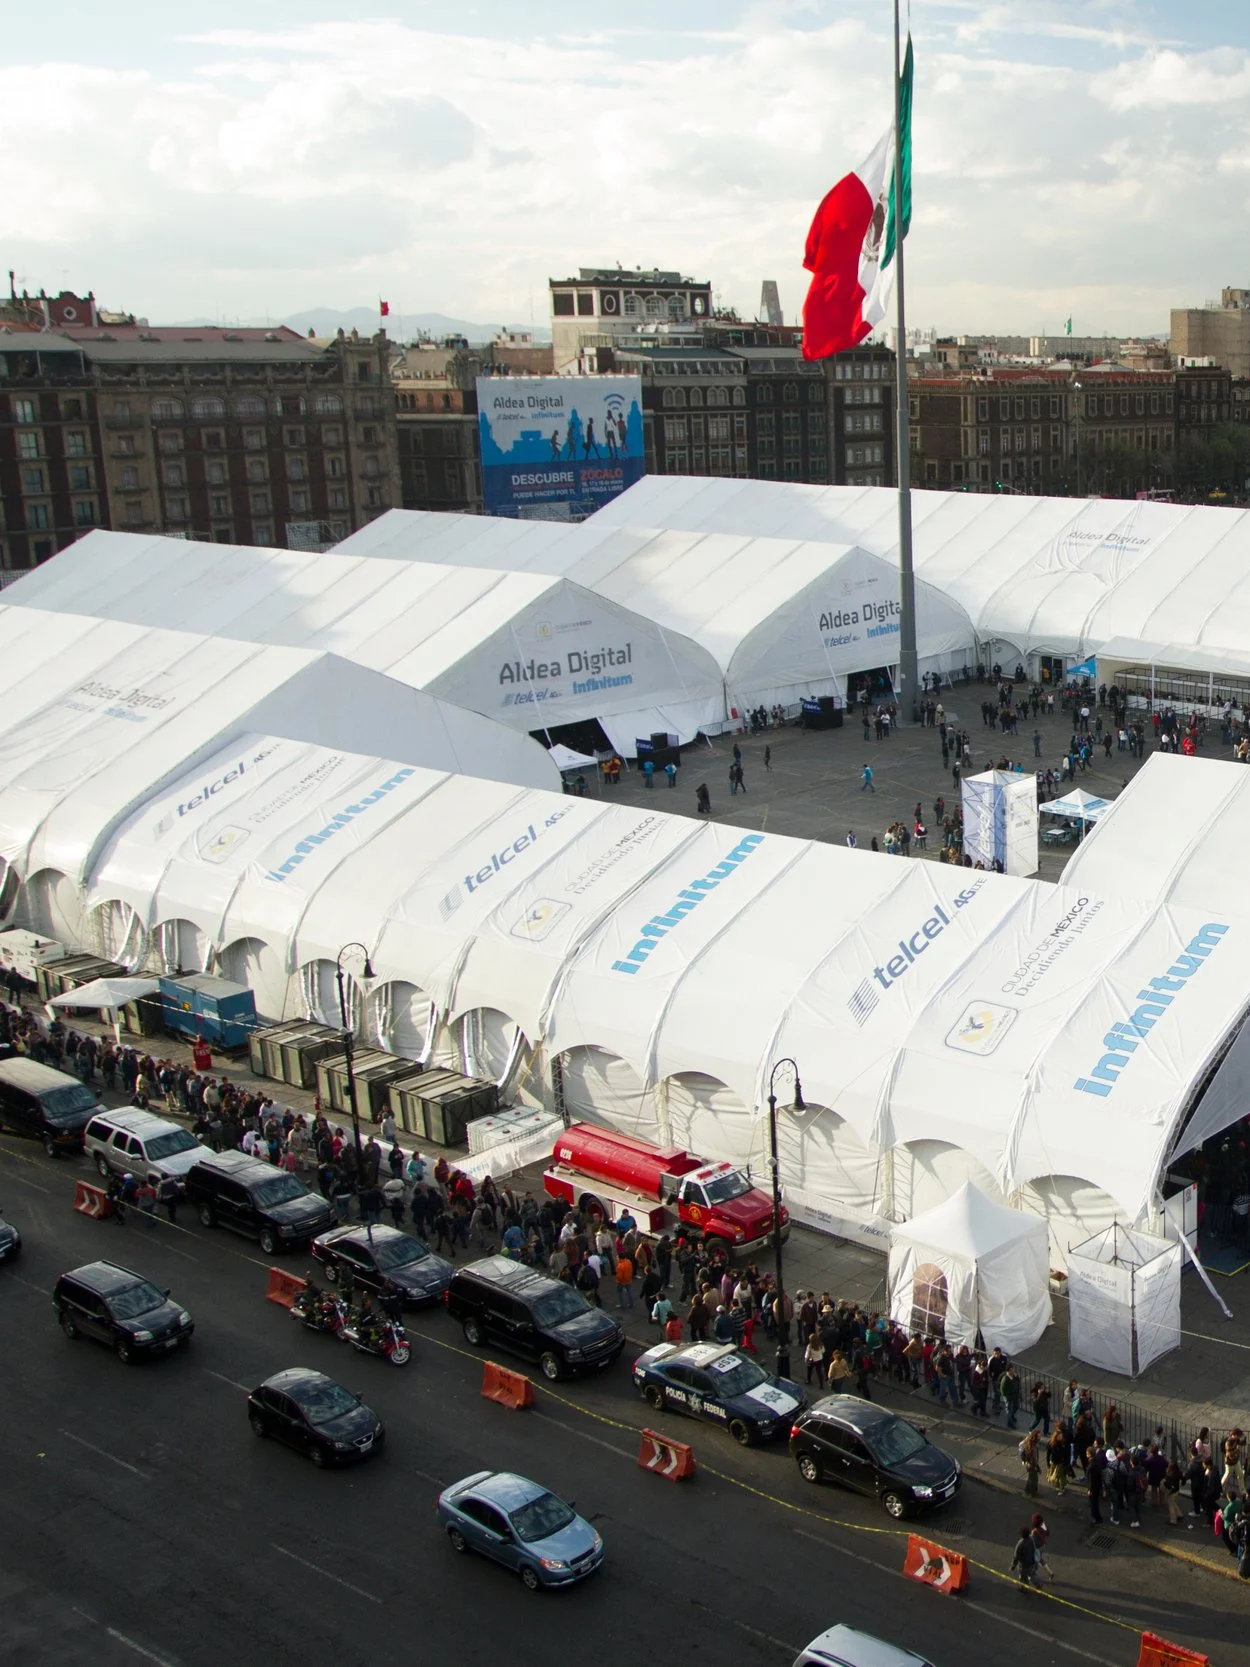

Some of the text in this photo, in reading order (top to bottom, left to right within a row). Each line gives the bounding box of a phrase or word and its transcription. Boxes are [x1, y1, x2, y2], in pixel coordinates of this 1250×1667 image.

[493, 395, 564, 411] Aldea Digital
[511, 471, 575, 486] DESCUBRE
[1067, 531, 1104, 540] Aldea
[1104, 532, 1151, 545] Digital
[819, 600, 901, 631] Aldea Digita
[499, 643, 632, 685] Aldea Digital
[514, 674, 633, 705] telcel infinitum
[176, 761, 246, 818] telcel
[264, 768, 416, 882] infinitum
[463, 824, 538, 894] telcel
[564, 858, 604, 892] CIUDAD
[601, 847, 619, 860] DE
[574, 818, 666, 894] Decidiendo Juntos
[610, 833, 766, 975] infinitum
[873, 904, 950, 990] telcel
[1001, 897, 1089, 994] CIUDAD DE MÉXICO
[1015, 899, 1105, 997] Decidiendo Juntos
[1072, 921, 1230, 1098] infinitum
[864, 1225, 885, 1237] telcel
[717, 1356, 737, 1369] SSP
[703, 1402, 727, 1418] FEDERAL
